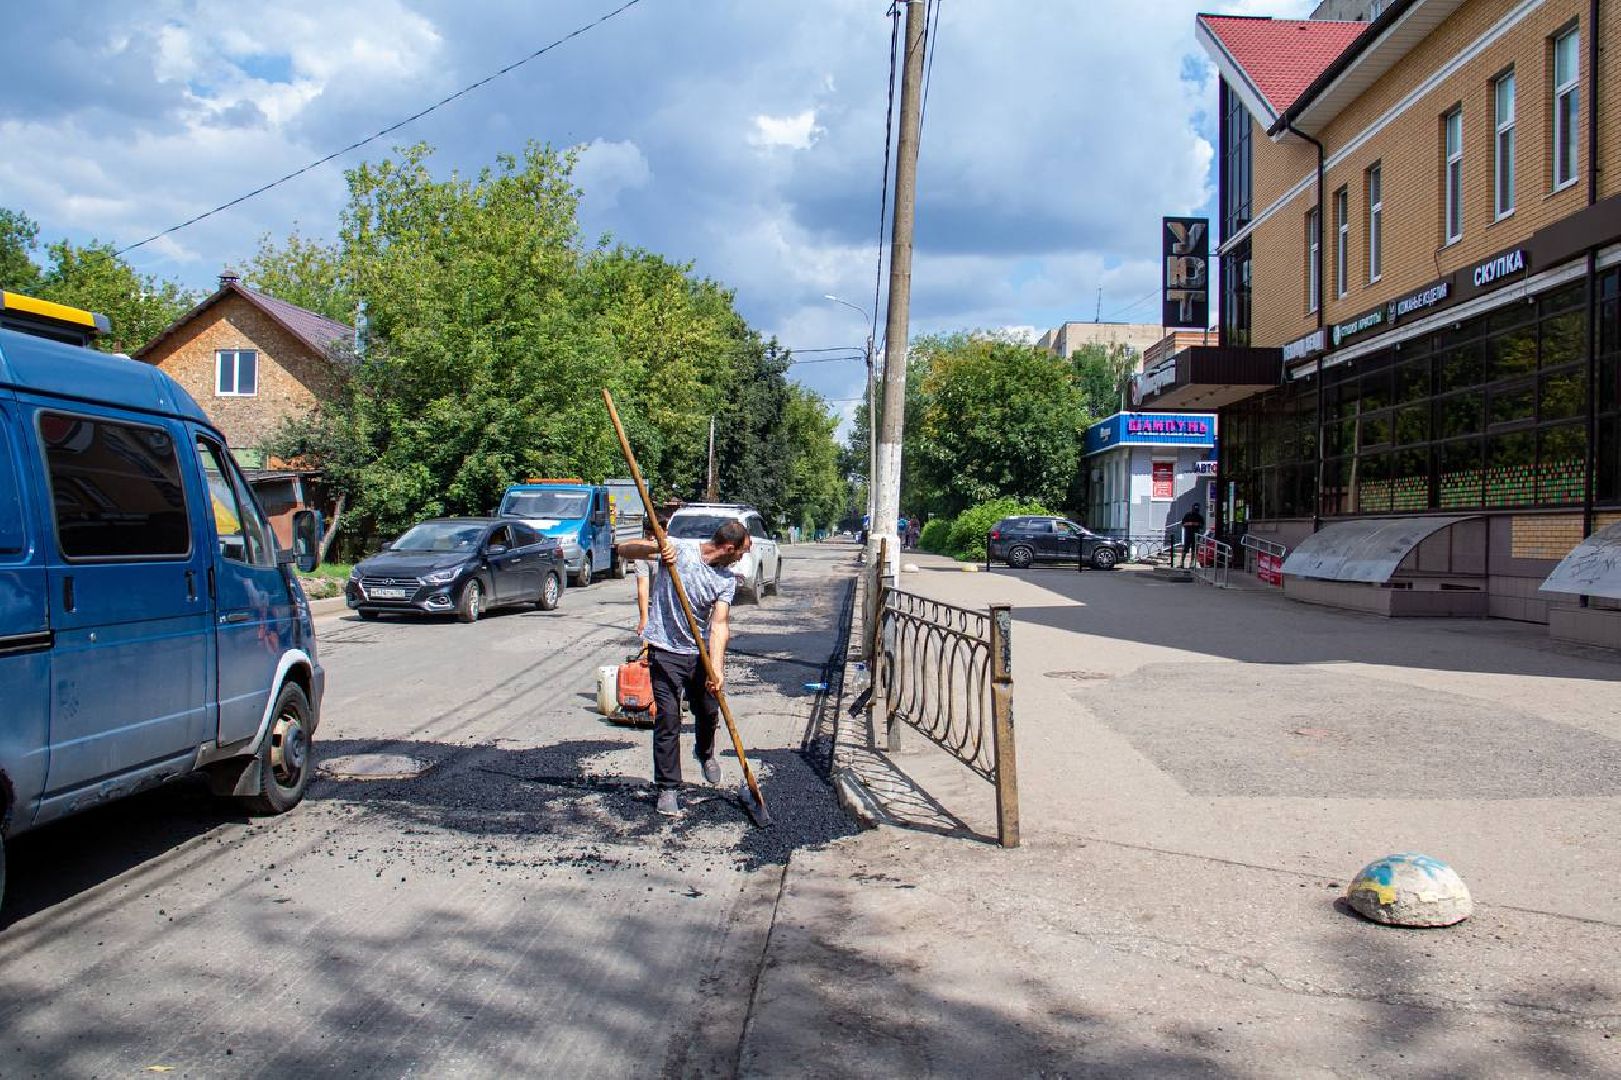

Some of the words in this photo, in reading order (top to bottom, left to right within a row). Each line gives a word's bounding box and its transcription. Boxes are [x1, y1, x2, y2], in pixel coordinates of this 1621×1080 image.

[1166, 221, 1206, 322] УЮТ
[1474, 249, 1524, 287] СКУПКА
[1127, 419, 1208, 434] ШАМПУНЬ
